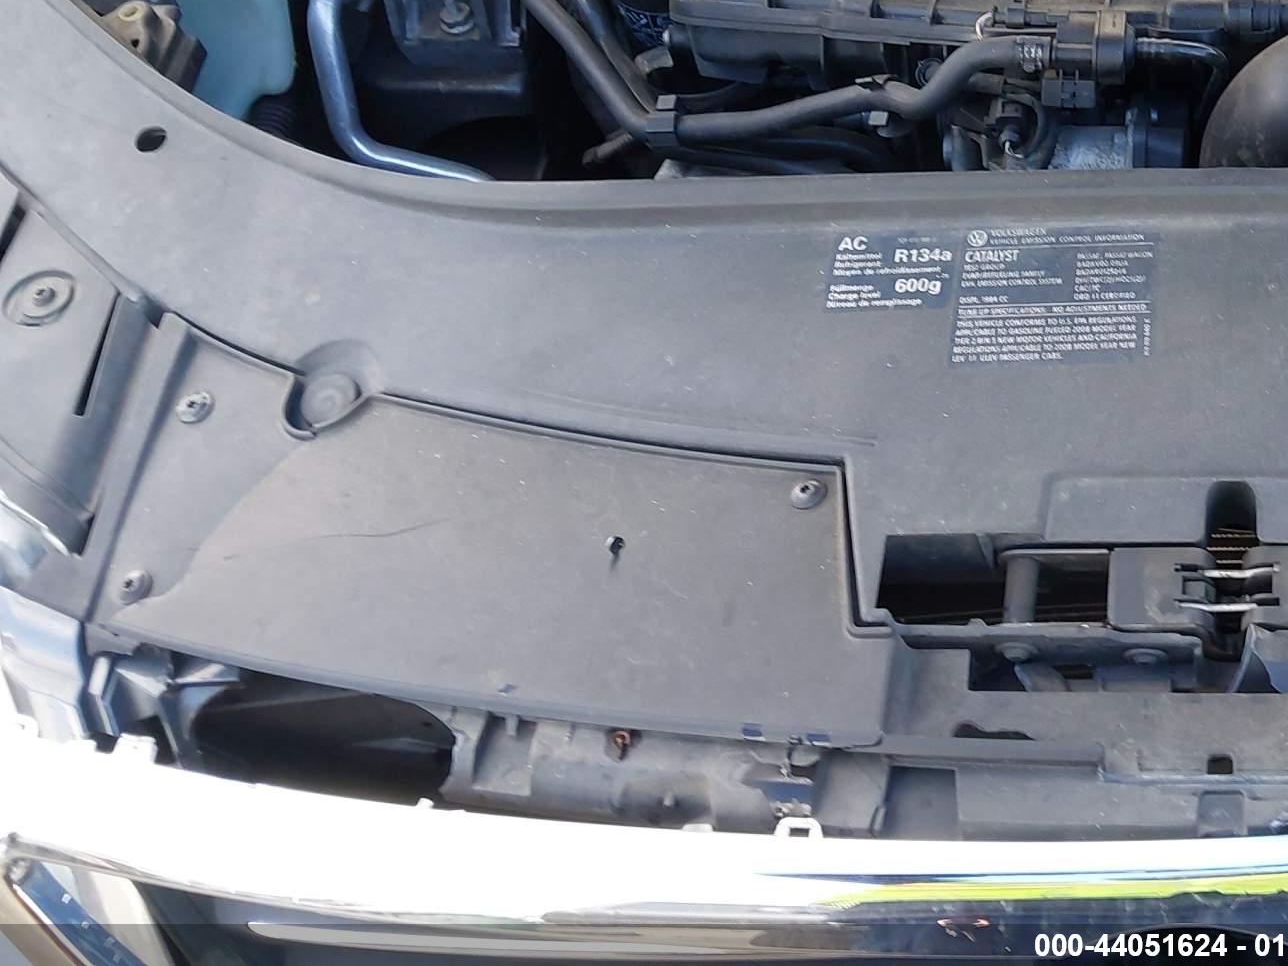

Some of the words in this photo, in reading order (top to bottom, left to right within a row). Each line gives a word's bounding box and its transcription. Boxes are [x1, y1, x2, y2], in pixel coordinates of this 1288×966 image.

[838, 236, 868, 251] AC
[1094, 233, 1144, 241] INFORMATION
[894, 248, 953, 263] R134a
[965, 249, 1020, 262] CATALYST
[894, 278, 942, 295] 600g
